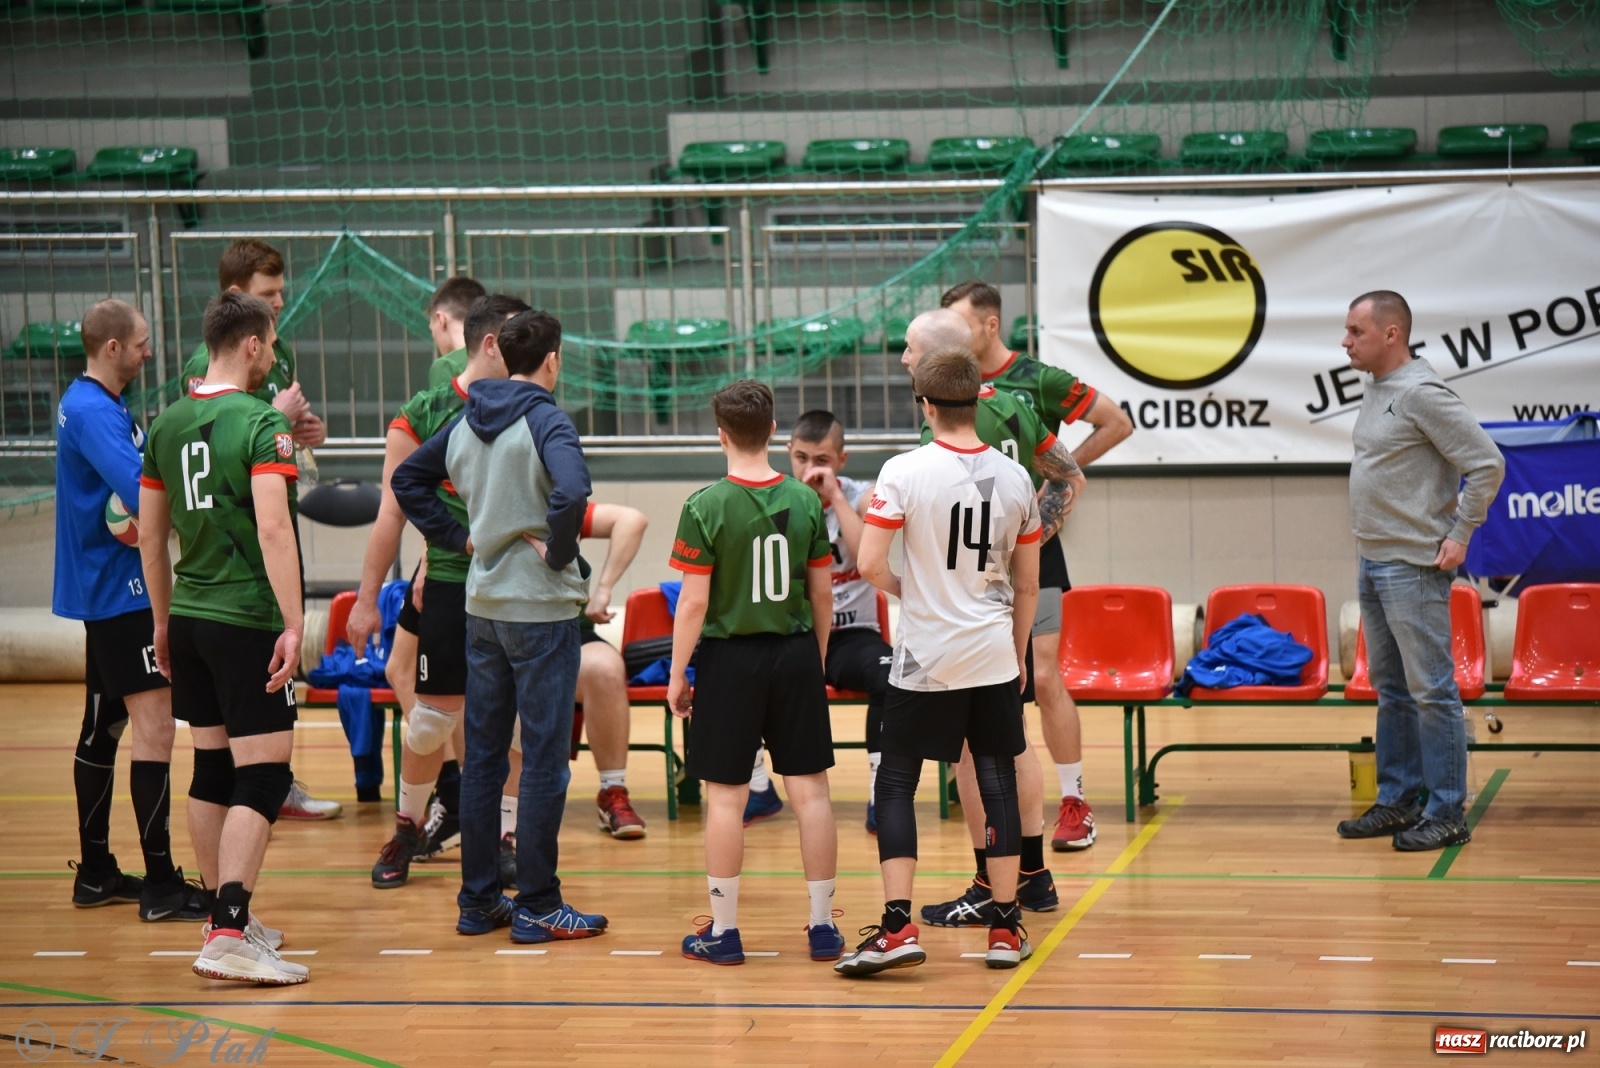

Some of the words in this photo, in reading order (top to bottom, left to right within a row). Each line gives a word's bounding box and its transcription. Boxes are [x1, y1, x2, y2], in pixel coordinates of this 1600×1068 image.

[1171, 248, 1252, 283] SIR
[1441, 321, 1492, 369] W
[1119, 391, 1271, 430] ACIBÓRZ
[181, 441, 213, 510] 12
[947, 501, 991, 572] 14
[128, 578, 143, 596] 13
[752, 533, 790, 603] 10
[420, 654, 428, 681] 9
